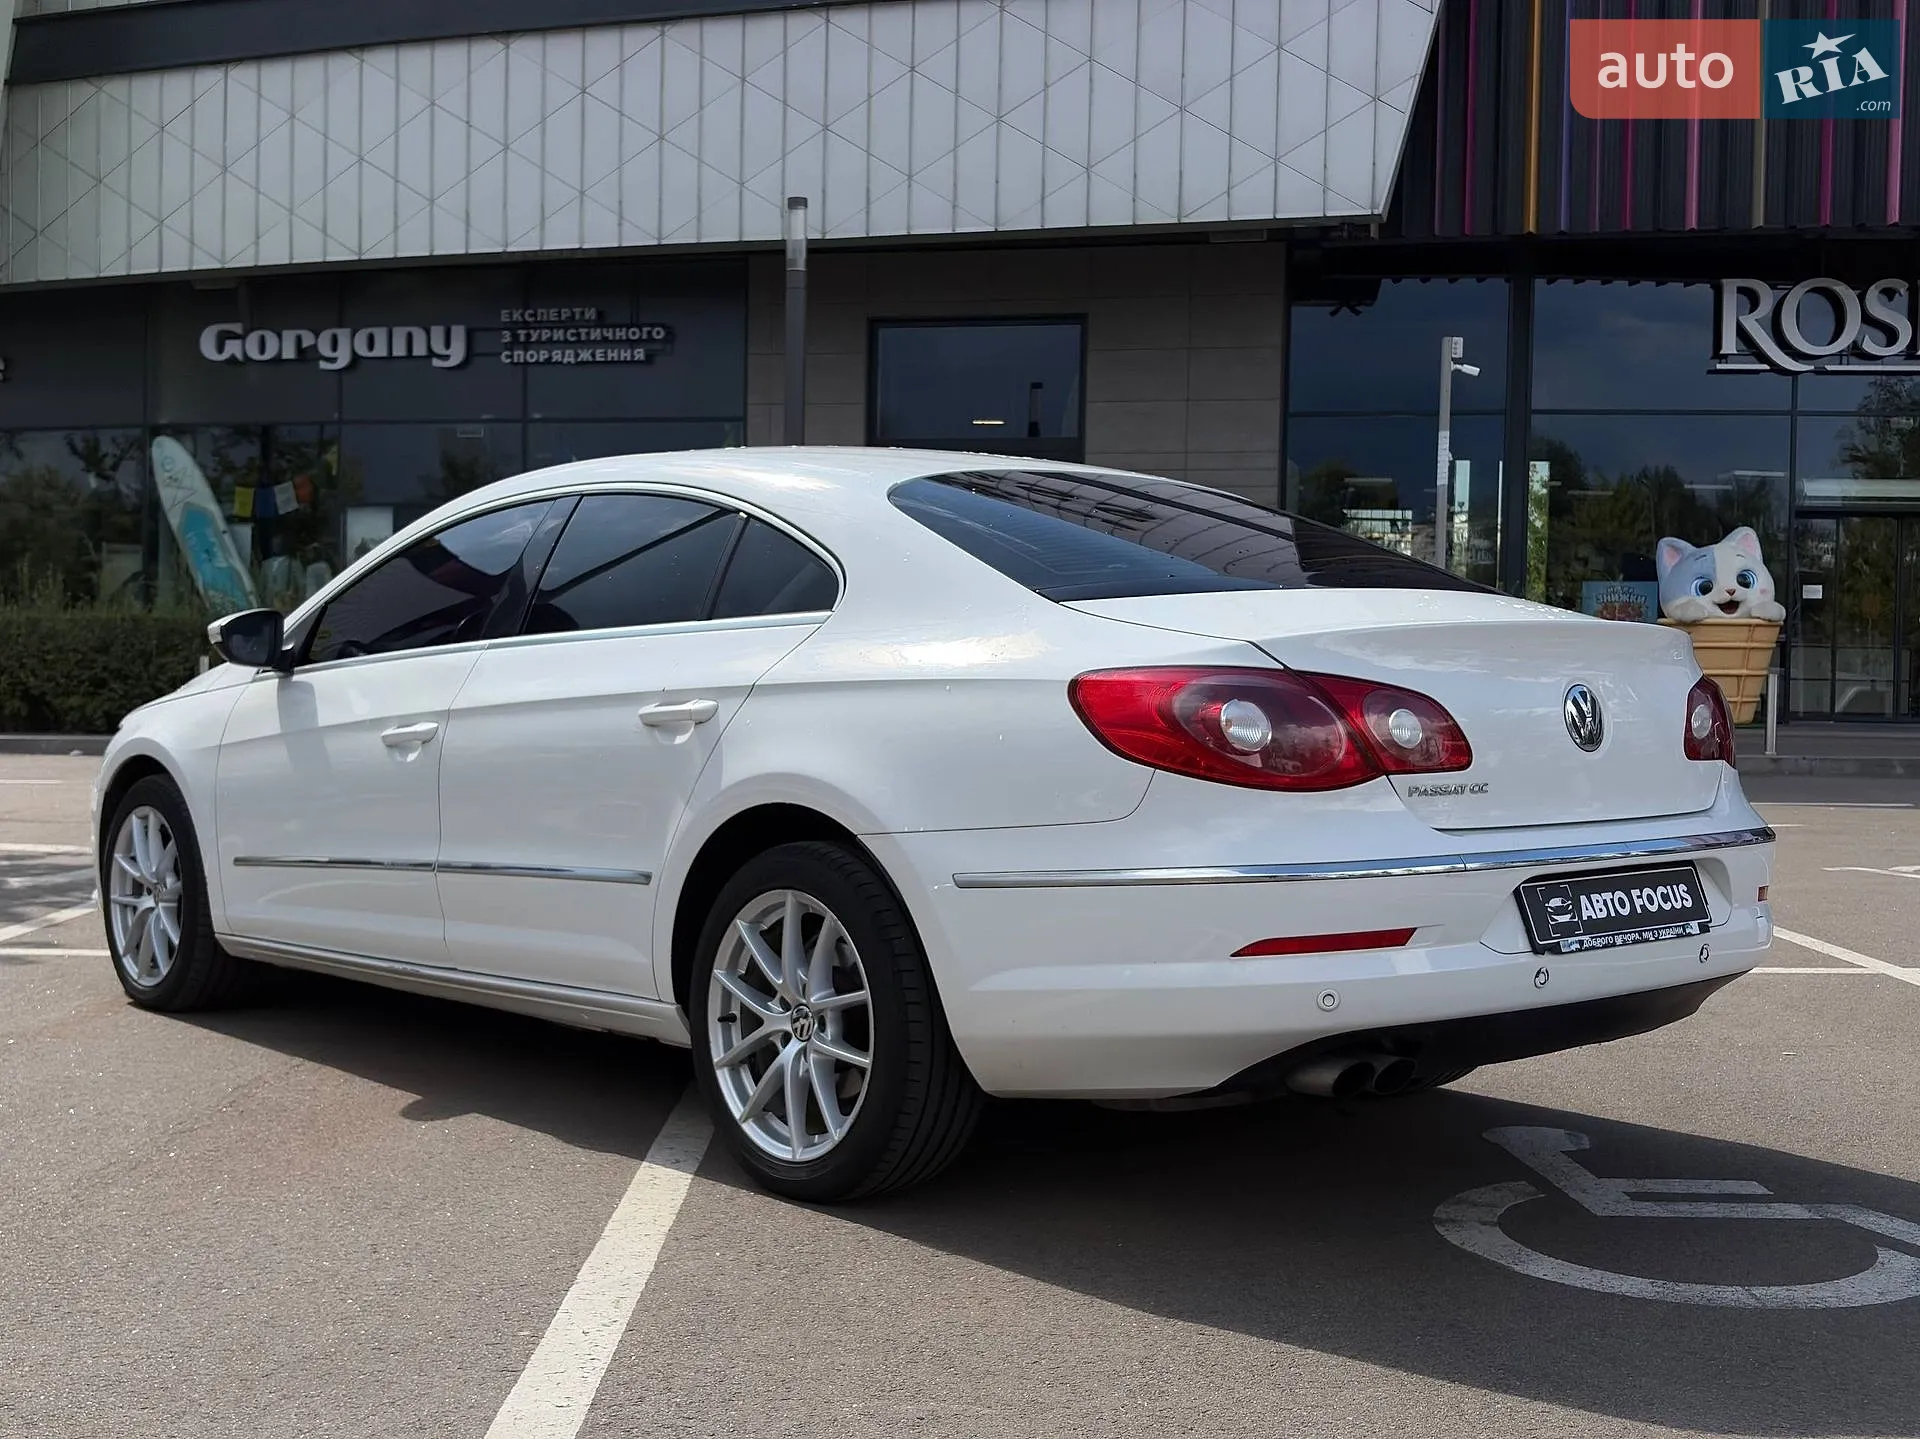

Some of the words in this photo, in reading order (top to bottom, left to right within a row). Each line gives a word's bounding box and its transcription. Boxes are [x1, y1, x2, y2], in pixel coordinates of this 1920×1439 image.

[500, 307, 598, 322] ЕКСПЕРТИ
[1719, 277, 1920, 372] ROS
[501, 330, 512, 343] З
[517, 327, 666, 342] ТУРИСТИЧНОГО
[200, 322, 468, 371] Gorgany
[500, 348, 646, 364] СПОРЯДЖЕННЯ
[1407, 784, 1467, 798] PASSAT
[1468, 782, 1489, 794] CC
[1580, 890, 1631, 921] АВТО
[1630, 884, 1693, 914] FOCUS
[1582, 936, 1613, 949] ДОБРОГО
